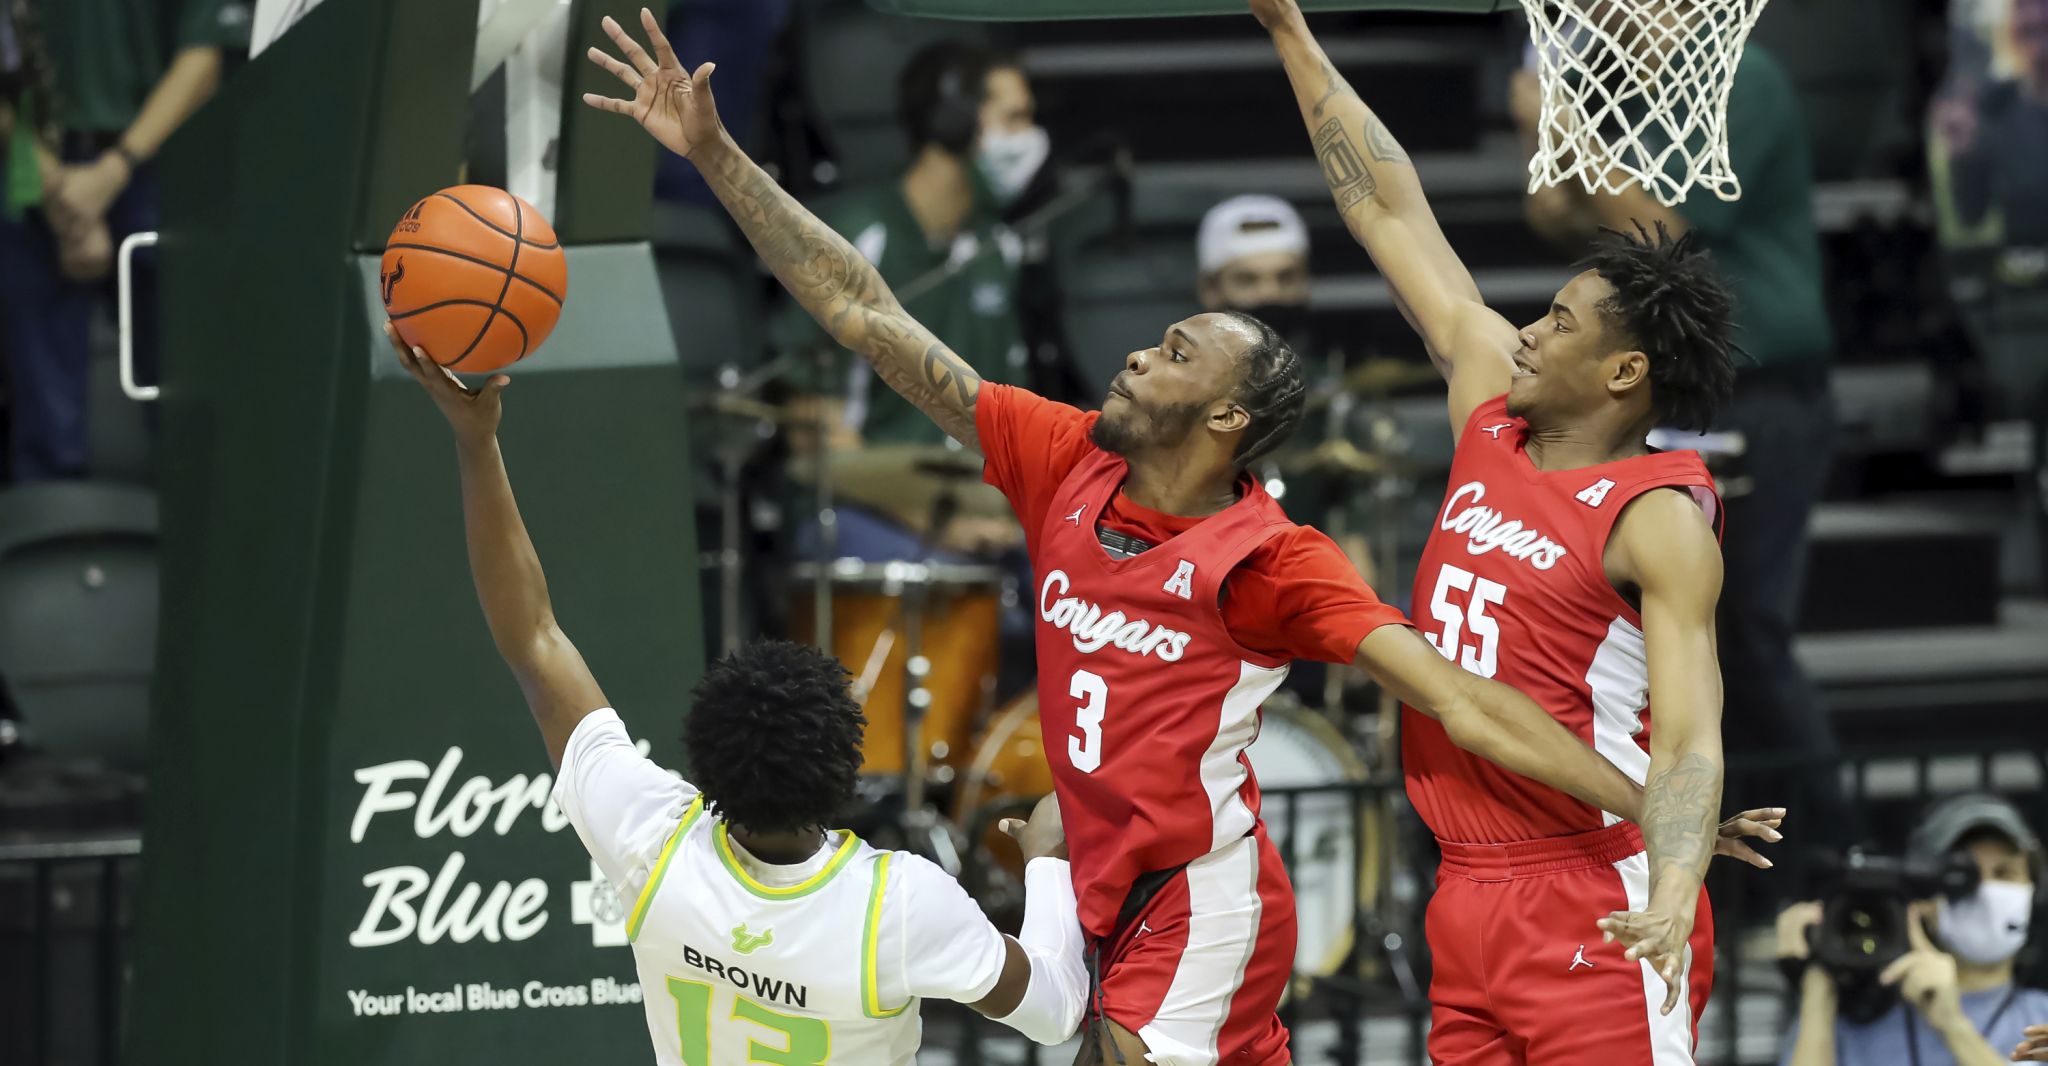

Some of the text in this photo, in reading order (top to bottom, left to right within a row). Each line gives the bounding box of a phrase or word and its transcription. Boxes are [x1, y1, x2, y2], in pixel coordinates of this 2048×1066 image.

[1441, 481, 1567, 570] Cougars
[1575, 477, 1616, 509] A
[1040, 569, 1192, 662] Cougars
[1162, 560, 1195, 600] A
[1424, 563, 1507, 679] 55
[1067, 669, 1109, 774] 3
[349, 851, 549, 947] Blue
[347, 976, 642, 1016] Your local Blue Cross Blue
[683, 944, 807, 1008] BROWN
